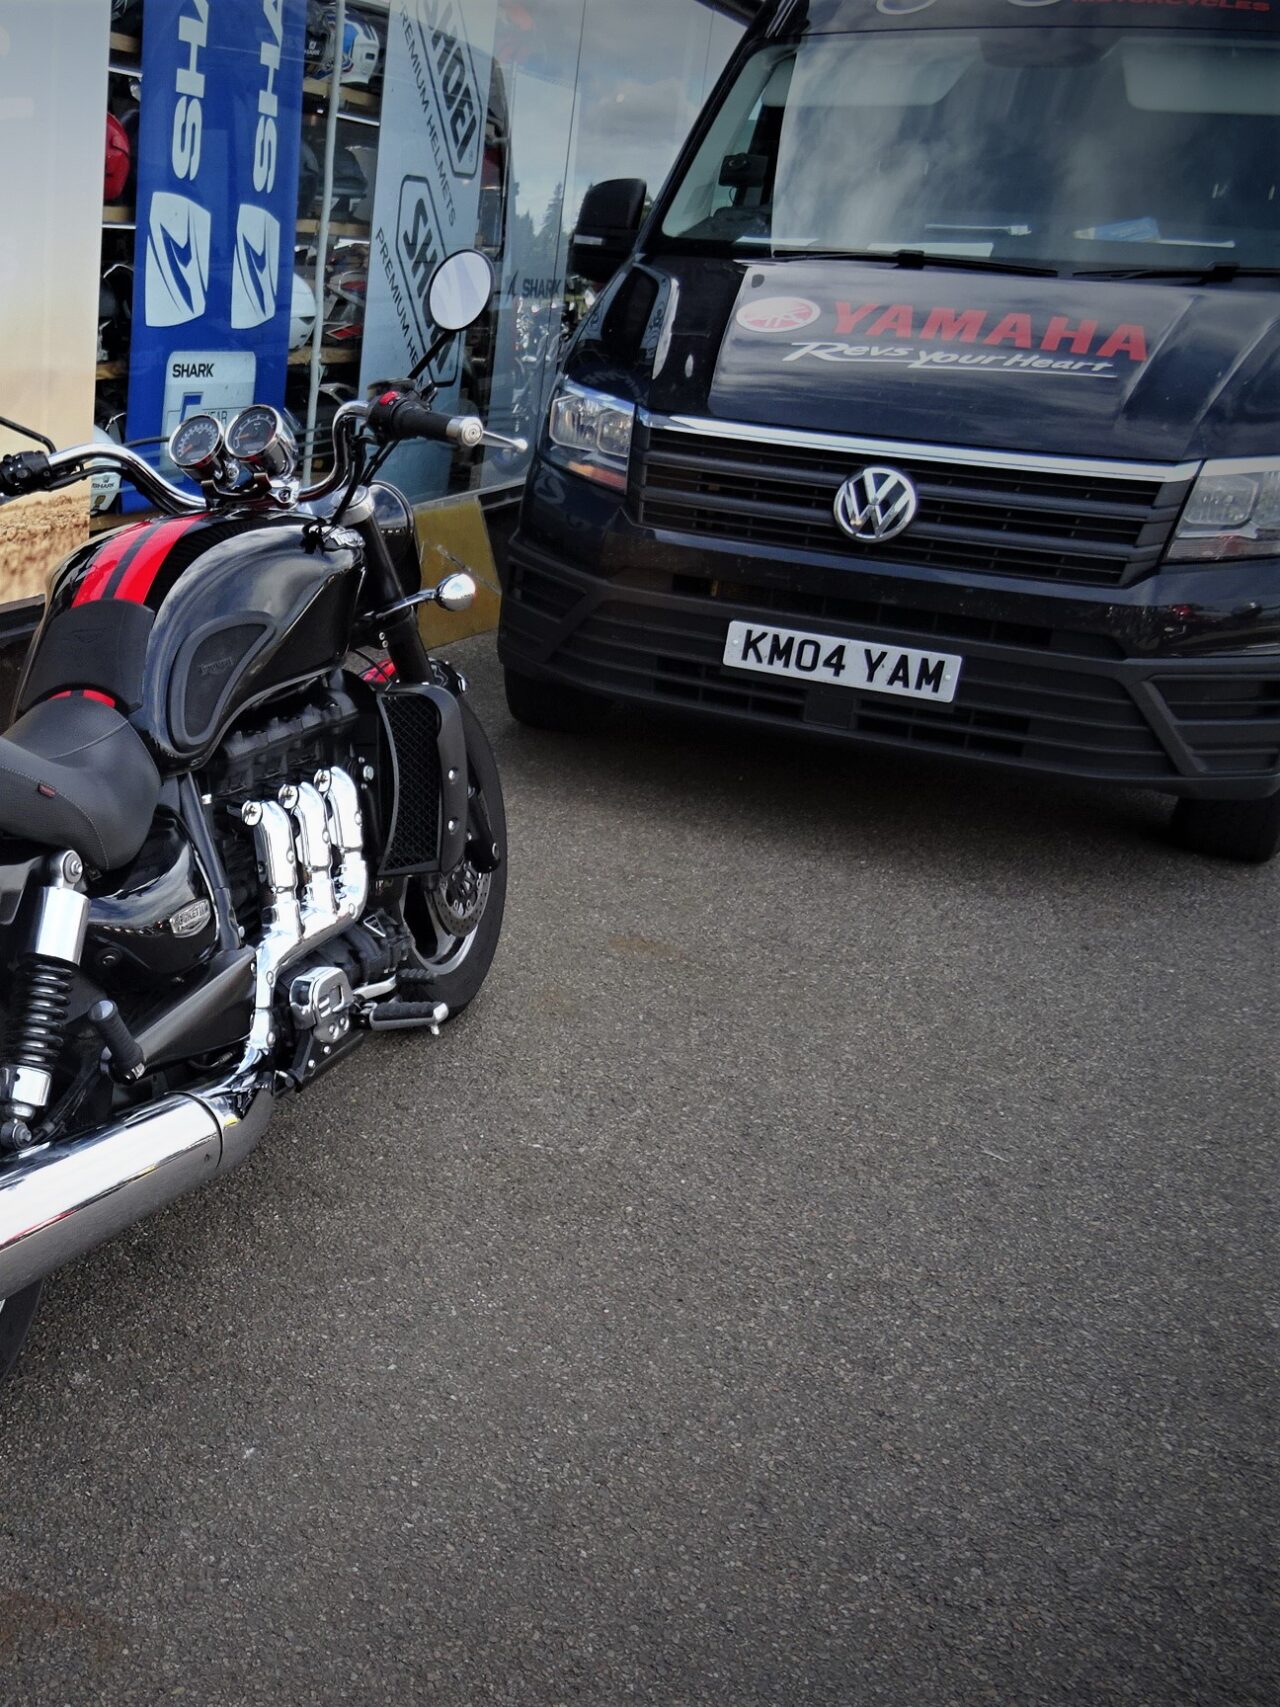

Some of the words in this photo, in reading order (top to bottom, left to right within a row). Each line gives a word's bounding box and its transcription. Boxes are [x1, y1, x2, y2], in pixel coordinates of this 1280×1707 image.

[400, 1, 430, 113] REMIUM
[427, 114, 457, 227] HELMETS
[376, 227, 410, 338] PREMIUM
[522, 278, 561, 298] SHARK
[782, 341, 914, 363] Revs
[908, 351, 1007, 369] your
[1003, 353, 1114, 372] Heart
[834, 301, 1148, 362] YAMAHA
[172, 363, 215, 378] SHARK
[740, 629, 846, 677] KM04
[864, 648, 946, 693] YAM
